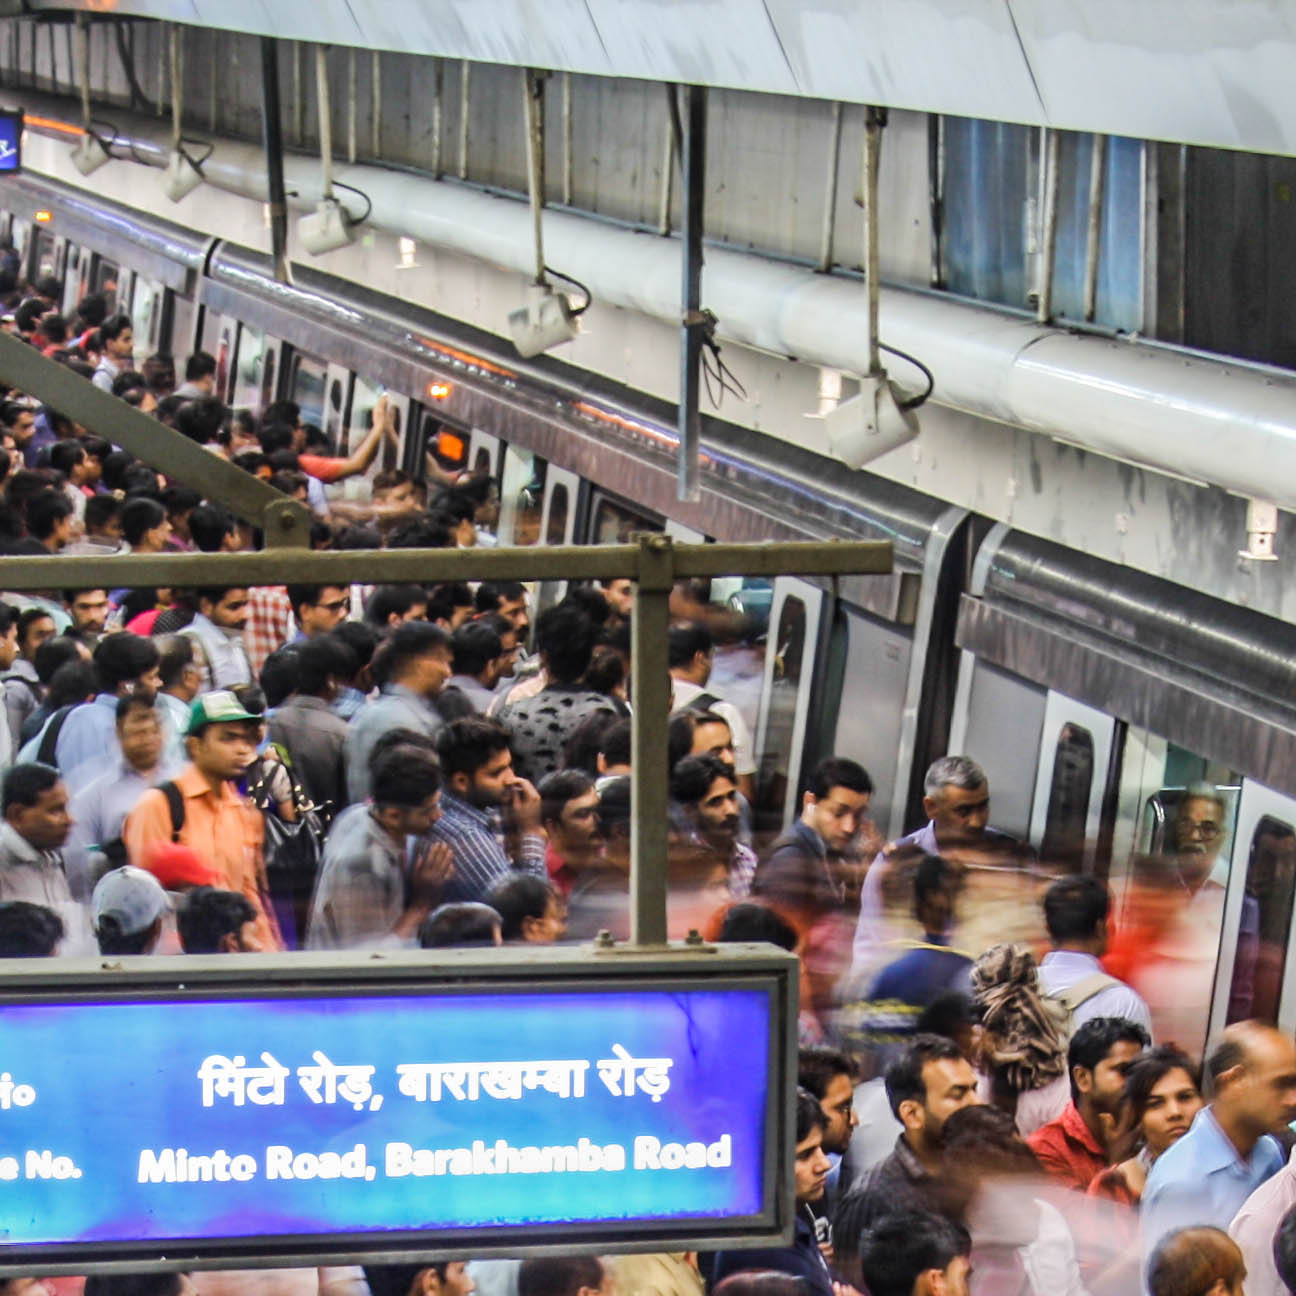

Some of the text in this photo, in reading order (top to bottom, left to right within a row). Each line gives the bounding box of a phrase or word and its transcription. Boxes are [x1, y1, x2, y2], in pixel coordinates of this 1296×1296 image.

[198, 1052, 287, 1107] मिंटो
[395, 1057, 590, 1102] बाराखम्बा
[597, 1044, 674, 1103] रोड़
[25, 1150, 83, 1180] No.
[138, 1135, 731, 1184] Minto Road, Barakhamba Road
